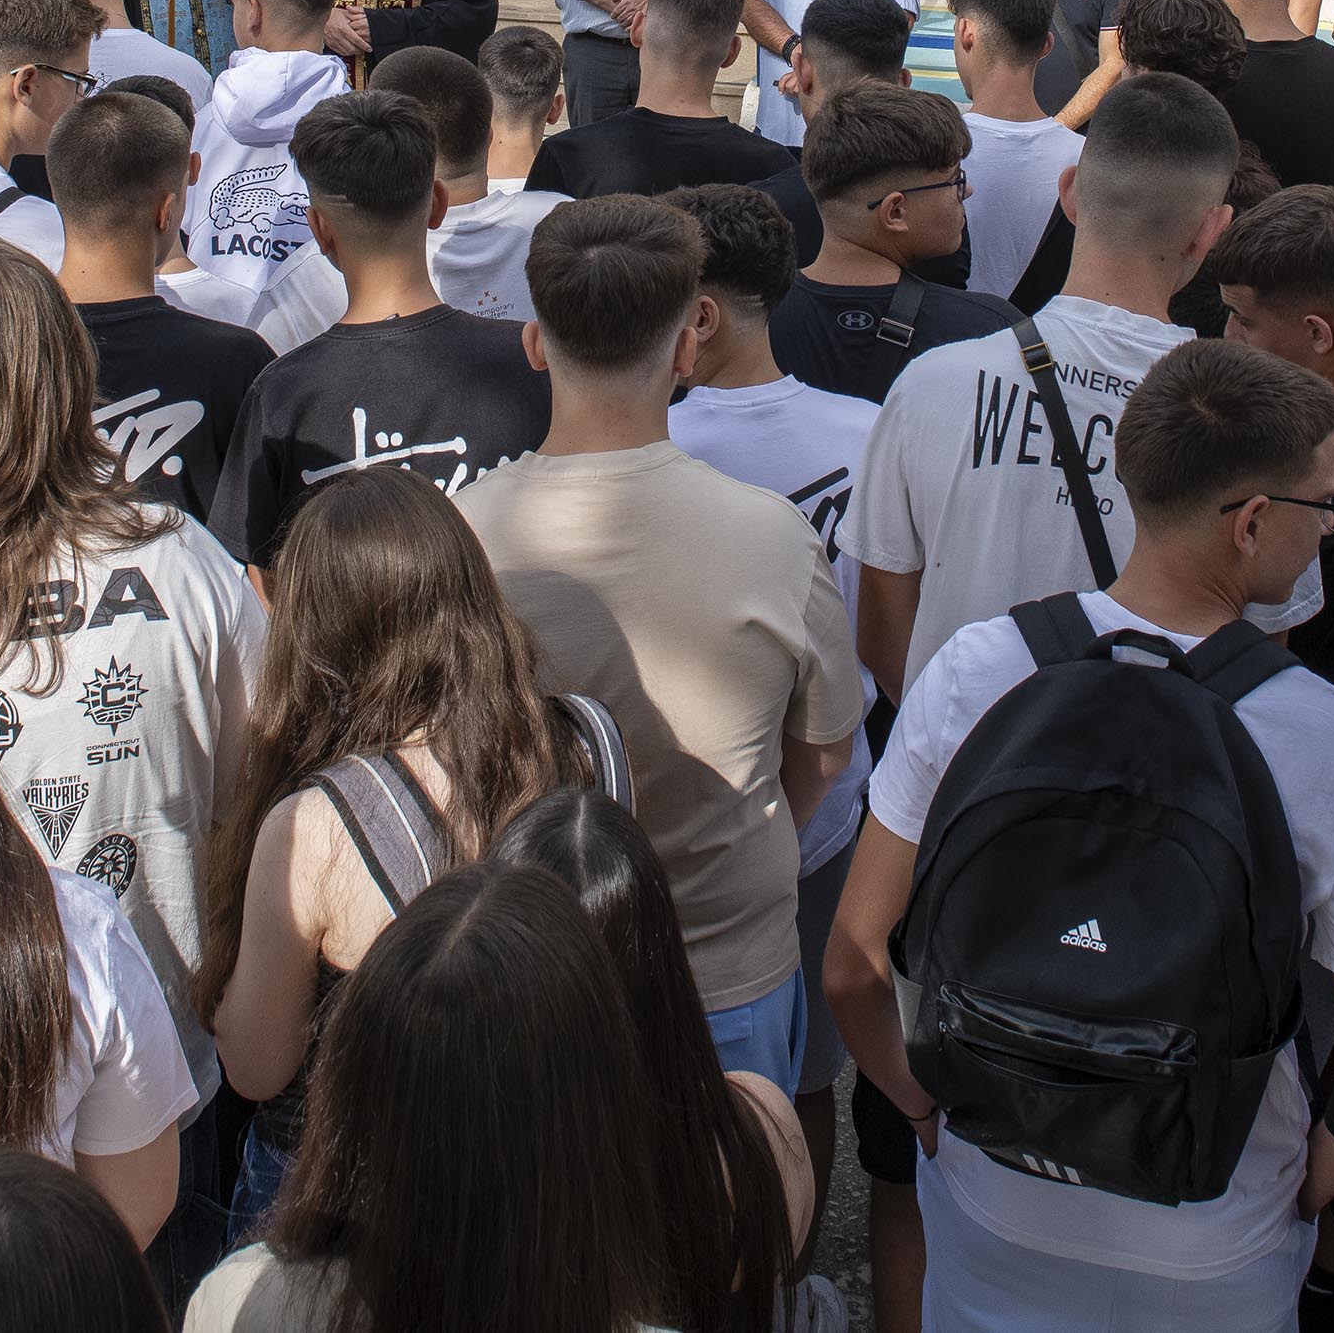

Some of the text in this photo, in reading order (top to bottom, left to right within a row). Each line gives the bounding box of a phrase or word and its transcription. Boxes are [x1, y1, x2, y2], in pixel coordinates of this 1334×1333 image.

[86, 738, 140, 751] CONNECTICUT
[87, 744, 140, 766] SUN
[30, 774, 82, 787] GOLDEN STATE
[22, 782, 89, 808] VALKYRIES
[1060, 934, 1107, 953] adidas
